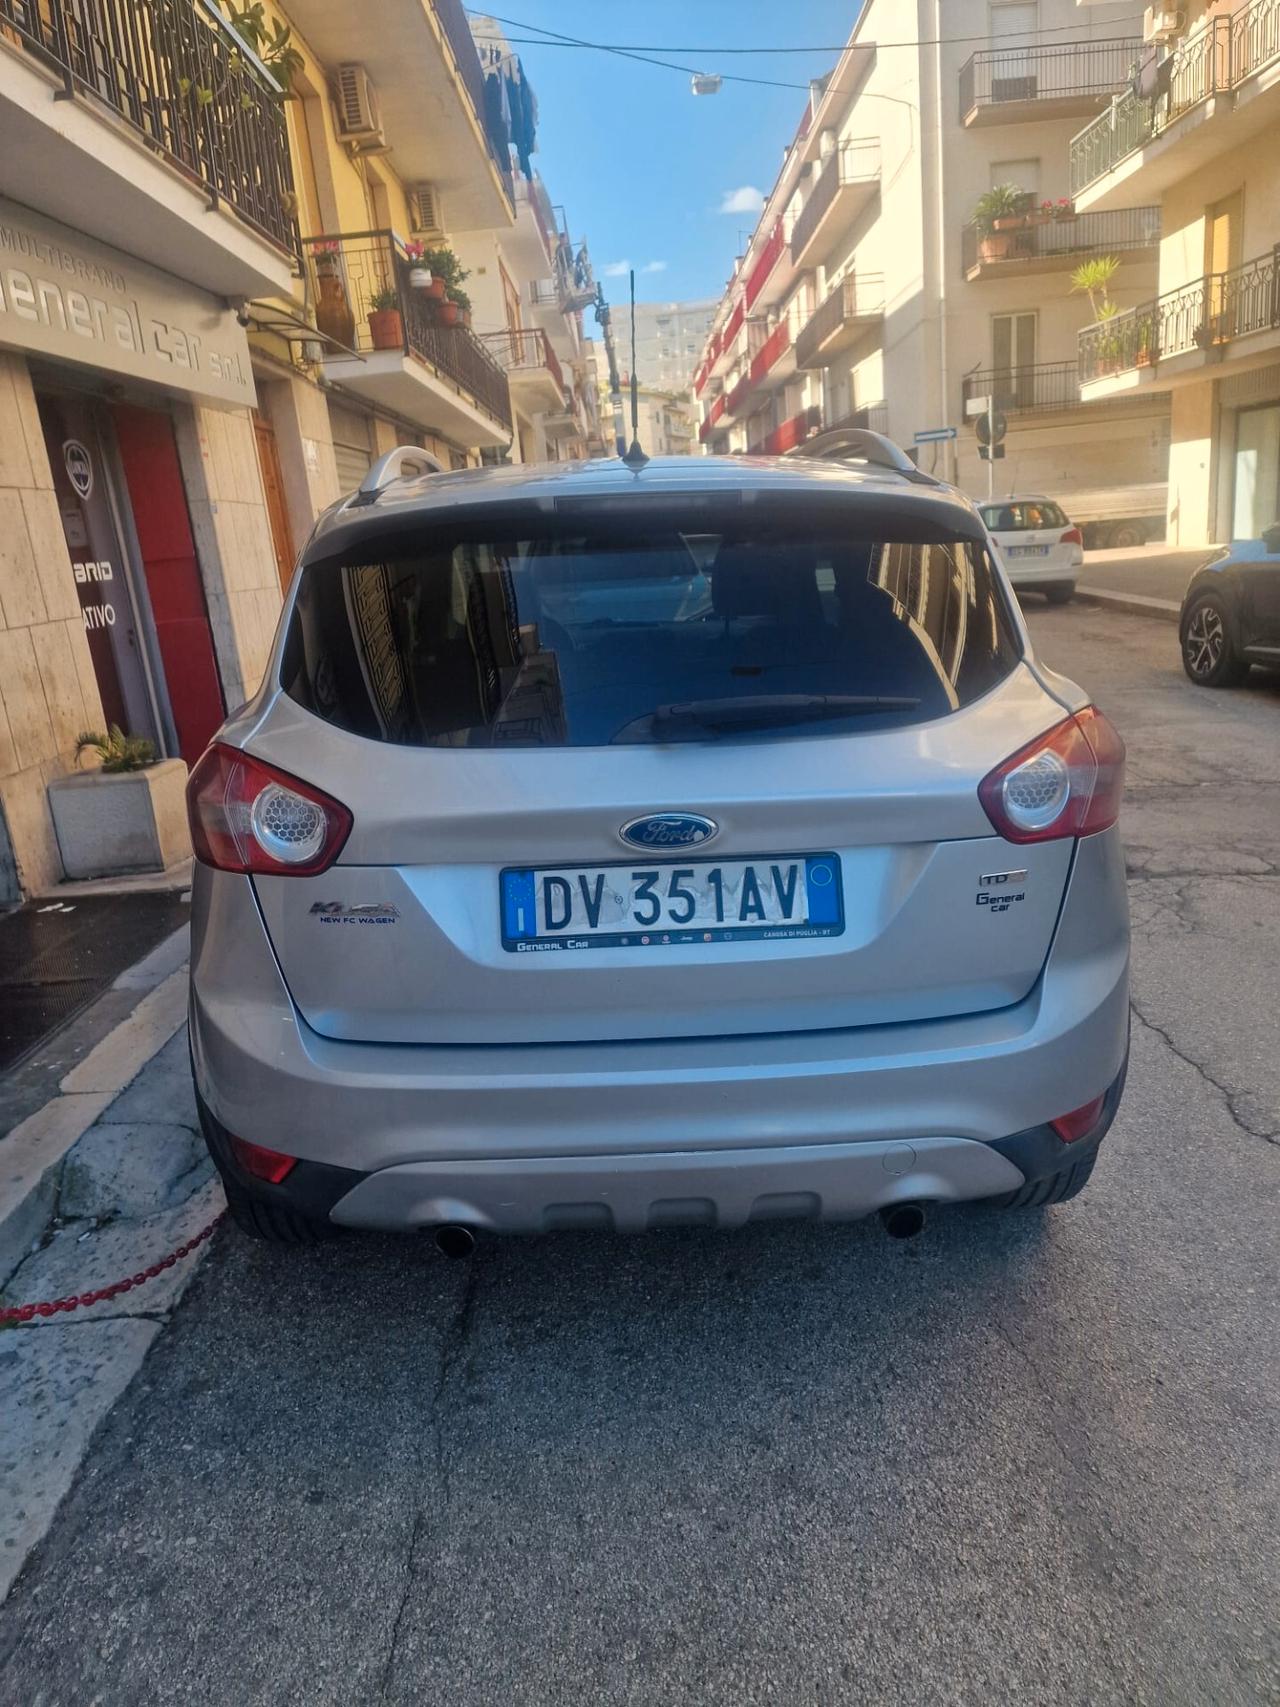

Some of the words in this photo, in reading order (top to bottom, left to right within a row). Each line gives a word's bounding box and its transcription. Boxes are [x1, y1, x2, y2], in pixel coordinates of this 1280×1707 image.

[643, 820, 698, 842] Ford
[543, 873, 605, 930] DV
[631, 864, 798, 926] 351AV
[976, 892, 1025, 905] General
